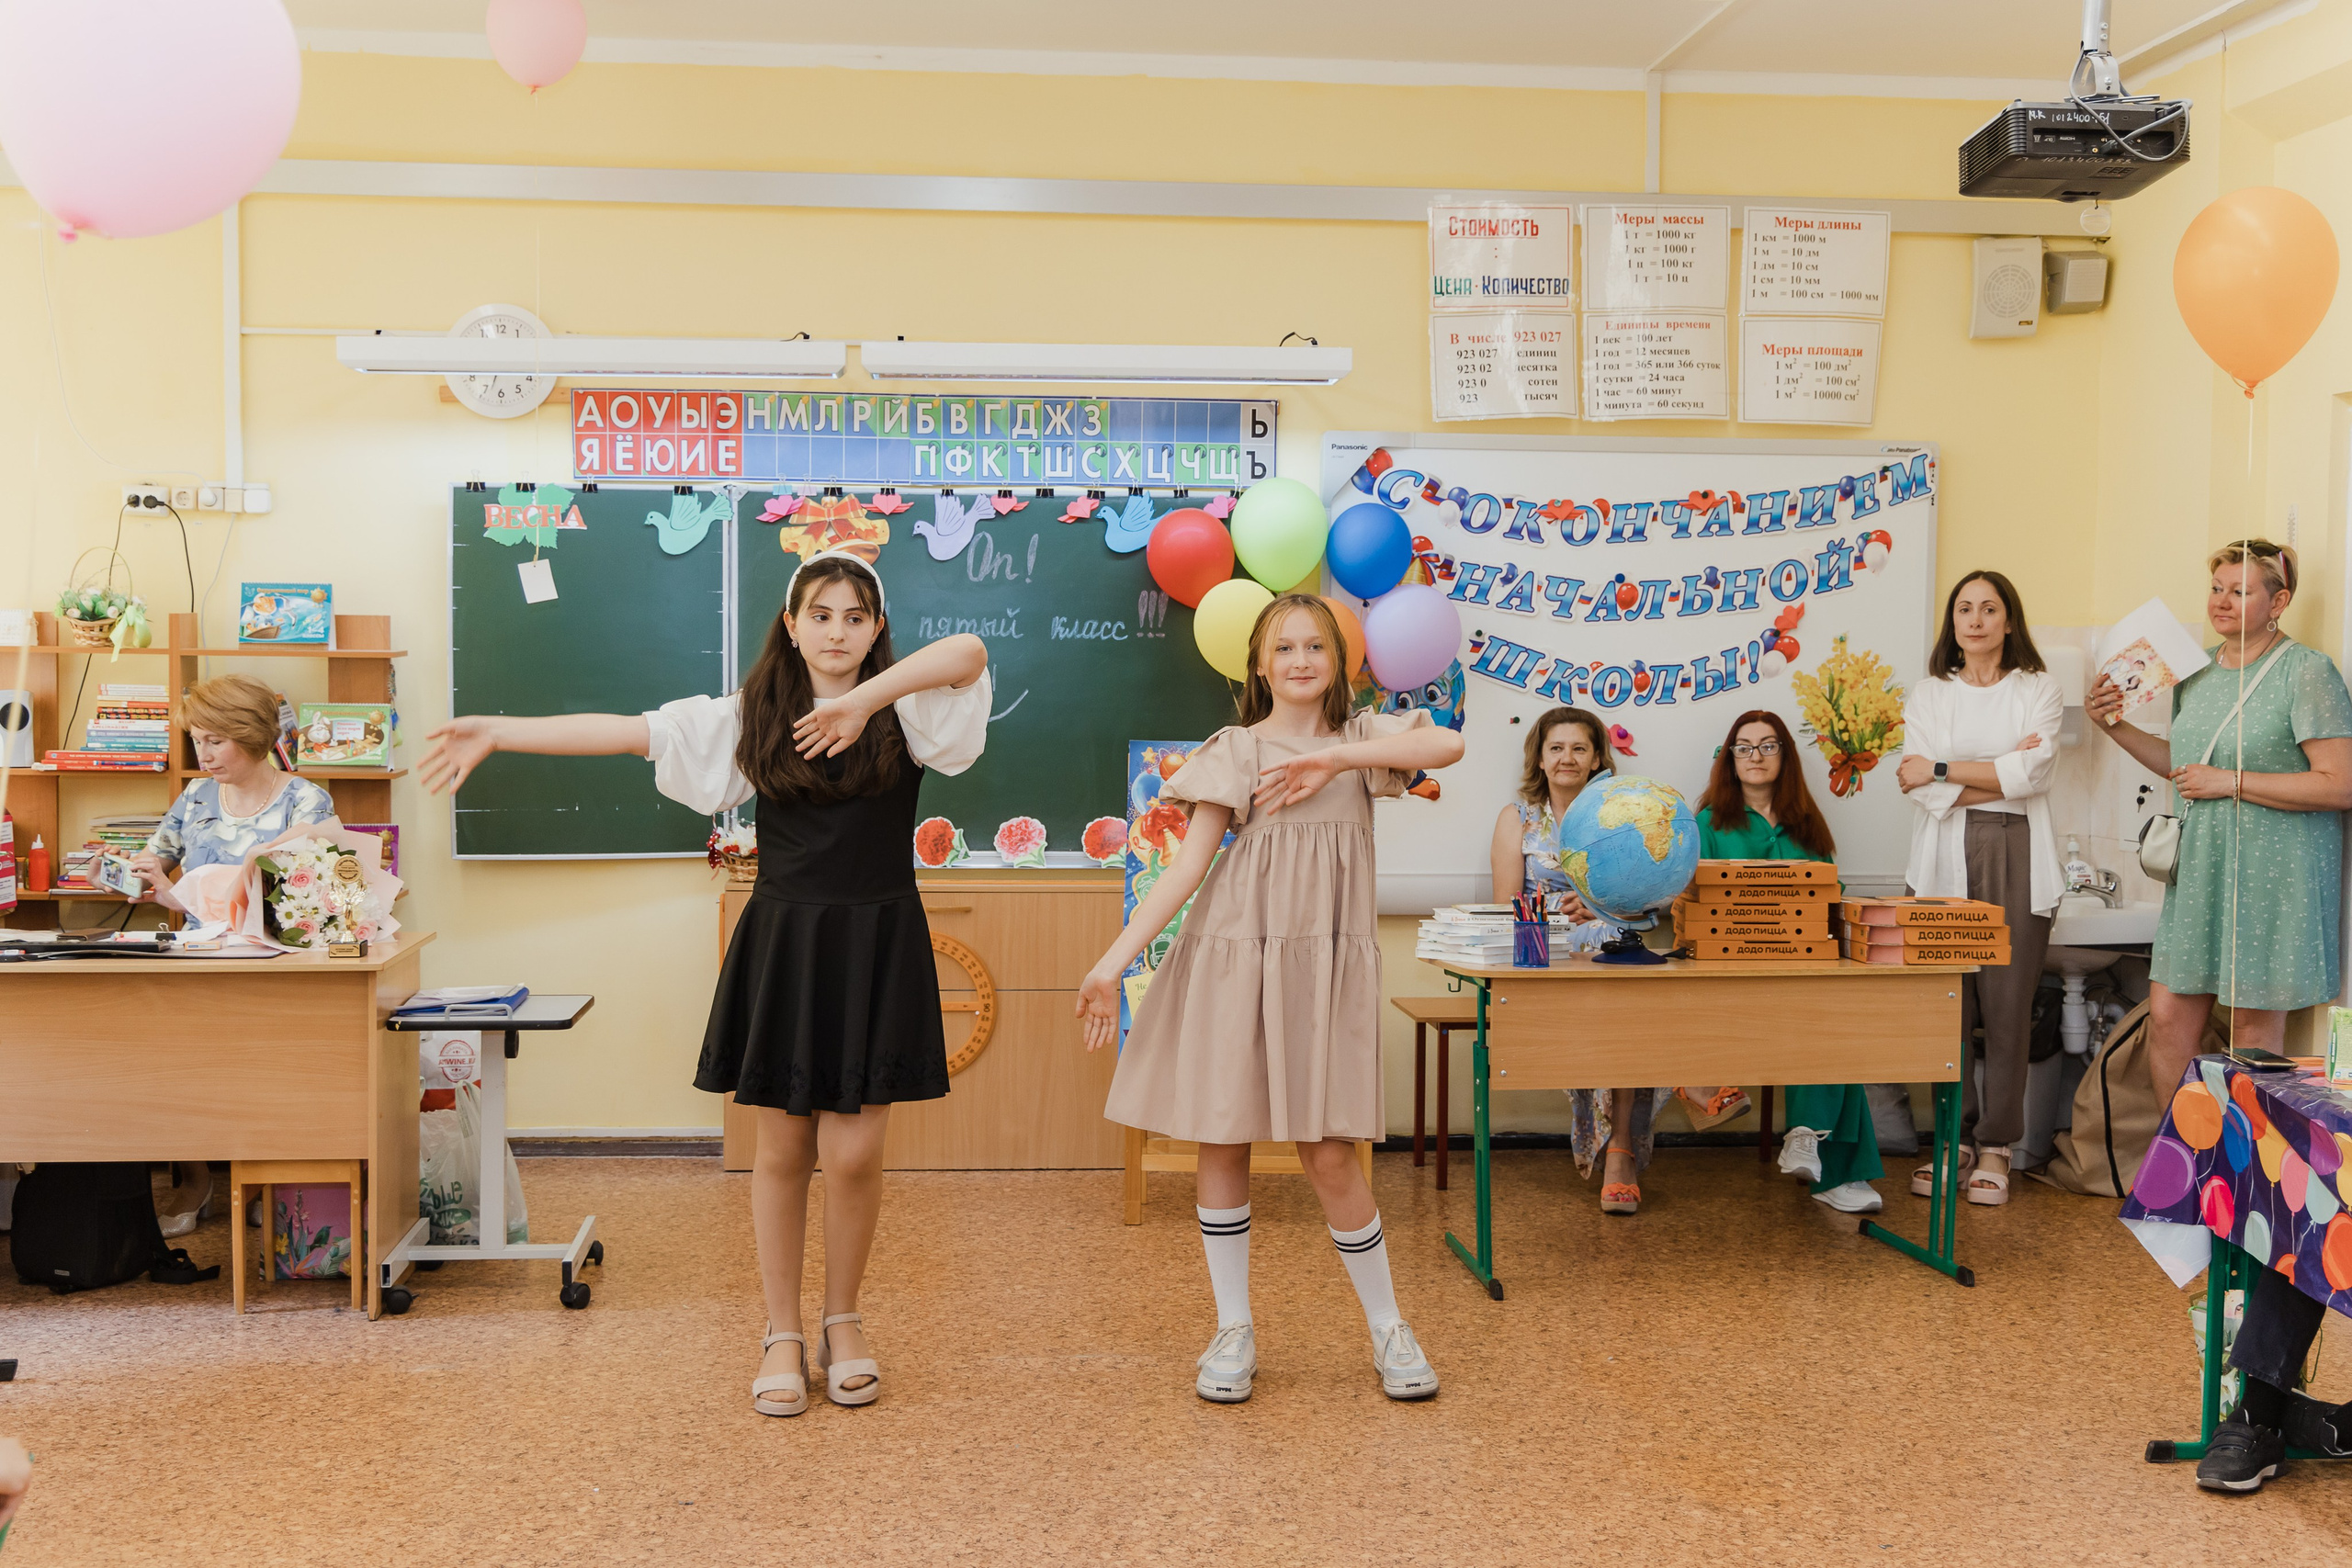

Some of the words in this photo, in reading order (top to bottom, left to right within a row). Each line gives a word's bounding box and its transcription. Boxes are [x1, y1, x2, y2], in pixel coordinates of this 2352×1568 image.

[1615, 213, 1655, 227] Меры
[1663, 216, 1703, 224] массы
[1775, 217, 1814, 231] Меры
[1817, 220, 1861, 230] длины
[1657, 231, 1680, 239] 1000
[1793, 234, 1815, 243] 1000
[1664, 245, 1687, 254] 1000
[1792, 248, 1803, 256] 10
[1661, 259, 1679, 267] 100
[1792, 262, 1802, 270] 10
[1668, 274, 1678, 282] 10
[1791, 276, 1801, 284] 10
[1791, 289, 1807, 299] 100
[1841, 291, 1861, 299] 1000
[496, 324, 506, 333] 12
[1606, 321, 1658, 331] Единицы
[1667, 321, 1711, 331] времени
[1451, 333, 1459, 344] В
[1514, 331, 1536, 343] 923
[1540, 331, 1561, 343] 027
[1456, 350, 1475, 359] 923
[1479, 349, 1498, 358] 027
[1636, 347, 1646, 355] 12
[1762, 344, 1803, 358] Меры
[1807, 345, 1862, 357] площади
[1457, 365, 1476, 374] 923
[1479, 364, 1491, 373] 02
[1635, 360, 1652, 368] 365
[1678, 360, 1693, 368] 366
[1696, 362, 1720, 370] суток
[1815, 361, 1831, 370] 100
[1458, 379, 1476, 389] 923
[1603, 377, 1633, 385] сутки
[1826, 377, 1842, 385] 100
[482, 384, 489, 394] 7
[497, 389, 505, 398] 6
[514, 384, 522, 394] 5
[1636, 387, 1647, 395] 60
[1651, 388, 1682, 397] минут
[1460, 394, 1478, 403] 923
[1814, 390, 1842, 400] 10000
[1657, 400, 1668, 408] 60
[1671, 400, 1704, 409] секунд
[1377, 468, 1426, 510] С
[1459, 453, 1931, 547] ОКОНЧАНИЕМ
[483, 503, 588, 530] ВЕСНА
[1447, 537, 1855, 622] НАЧАЛЬНОЙ
[919, 607, 1023, 639] пятый
[1050, 616, 1128, 640] класс
[1469, 635, 1761, 708] ШКОЛЫ!
[1736, 871, 1762, 879] ДОДО
[1764, 871, 1797, 879] ПИЦЦА
[1724, 908, 1752, 917] ДОДО
[1753, 908, 1787, 917] ПИЦЦА
[1909, 913, 1944, 922] ДОДО
[1946, 913, 1989, 922] ПИЦЦА
[1724, 927, 1752, 935] ДОДО
[1753, 927, 1787, 935] ПИЦЦА
[1918, 931, 1952, 941] ДОДО
[1954, 931, 1996, 941] ПИЦЦА
[1736, 946, 1763, 954] ДОДО
[1765, 946, 1798, 954] ПИЦЦА
[1917, 950, 1952, 960] ДОДО
[1954, 950, 1996, 960] ПИЦЦА
[983, 1002, 990, 1012] 90
